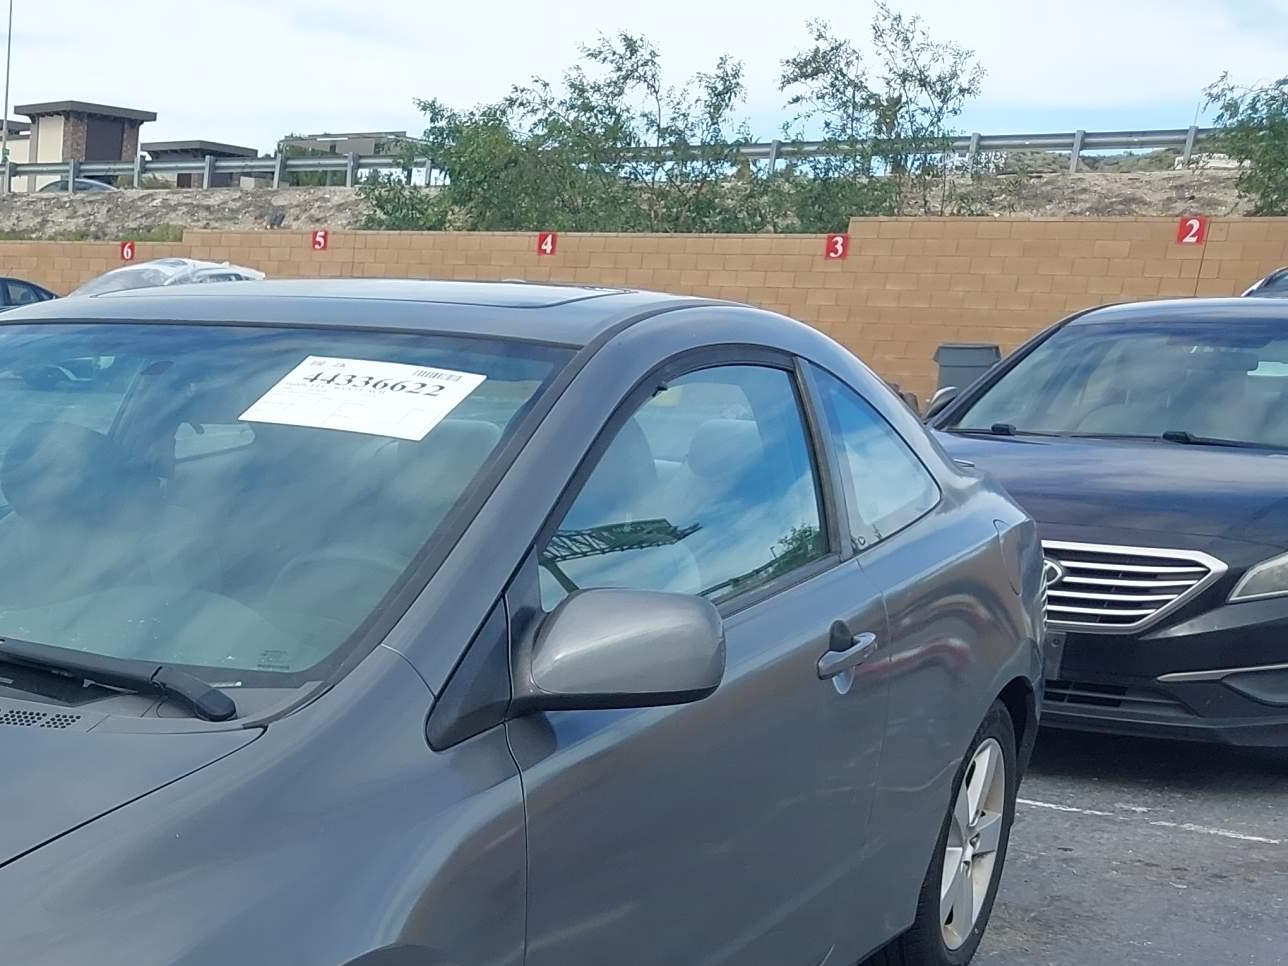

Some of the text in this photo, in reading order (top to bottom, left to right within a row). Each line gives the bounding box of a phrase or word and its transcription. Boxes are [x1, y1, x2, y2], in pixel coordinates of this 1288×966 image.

[314, 231, 326, 249] 5
[1182, 219, 1200, 243] 2
[123, 242, 132, 260] 6
[541, 233, 552, 254] 4
[830, 236, 844, 258] 3
[303, 371, 445, 397] 44336622
